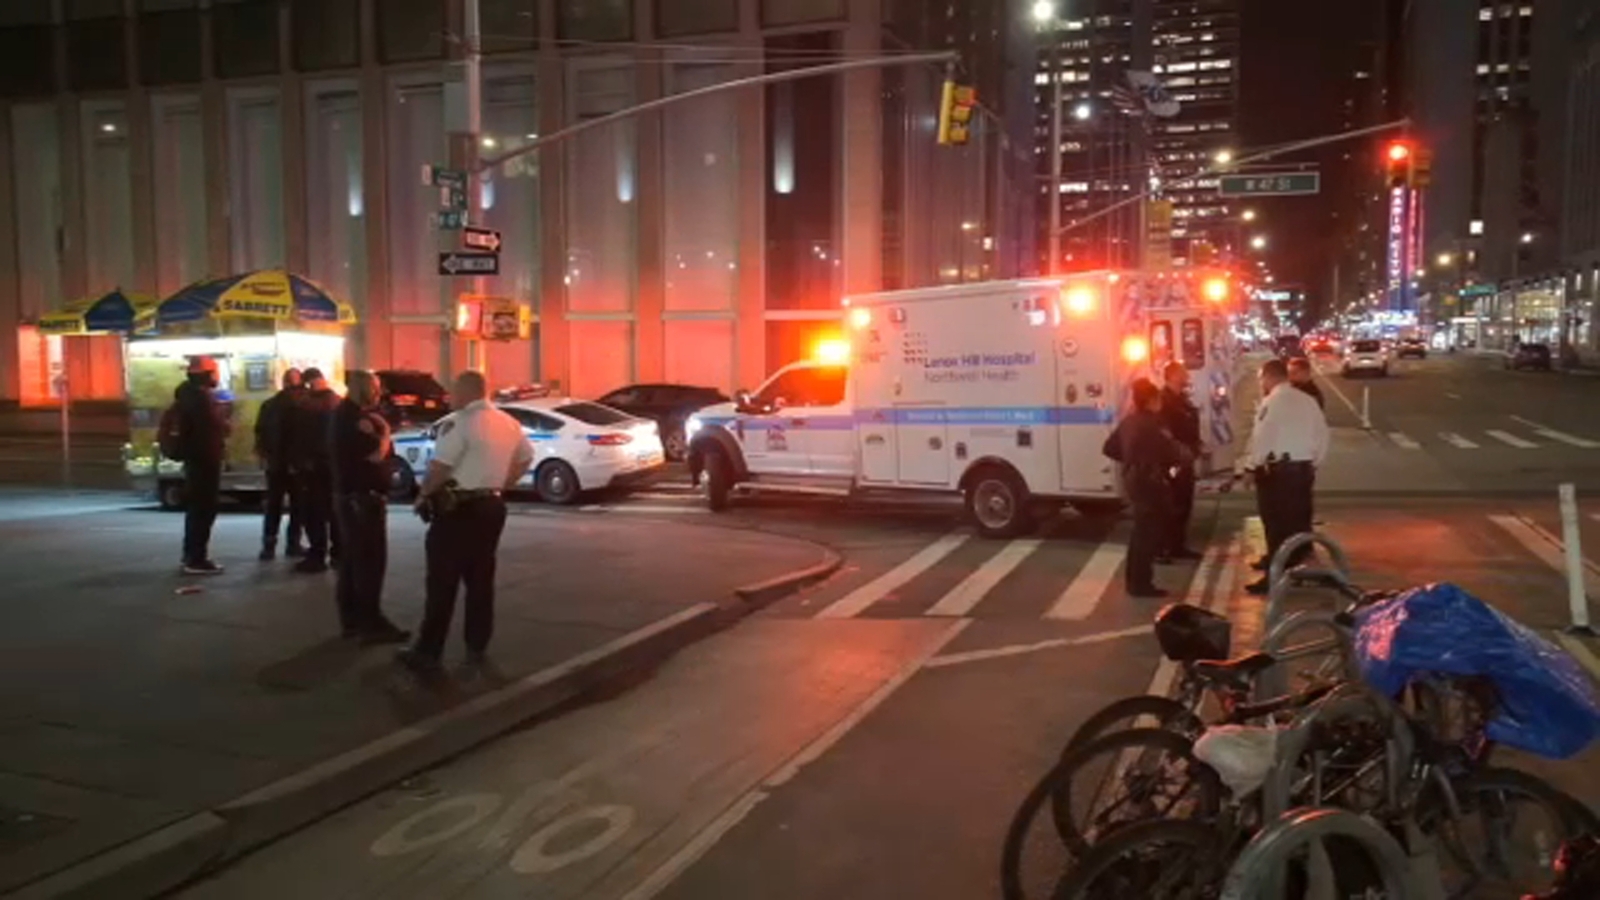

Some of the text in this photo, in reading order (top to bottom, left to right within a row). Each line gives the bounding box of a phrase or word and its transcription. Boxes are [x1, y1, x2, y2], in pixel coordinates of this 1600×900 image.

[1389, 240, 1400, 277] CITY
[223, 300, 289, 315] SABRETT
[924, 355, 958, 368] Lenox
[983, 351, 1035, 366] Hospital
